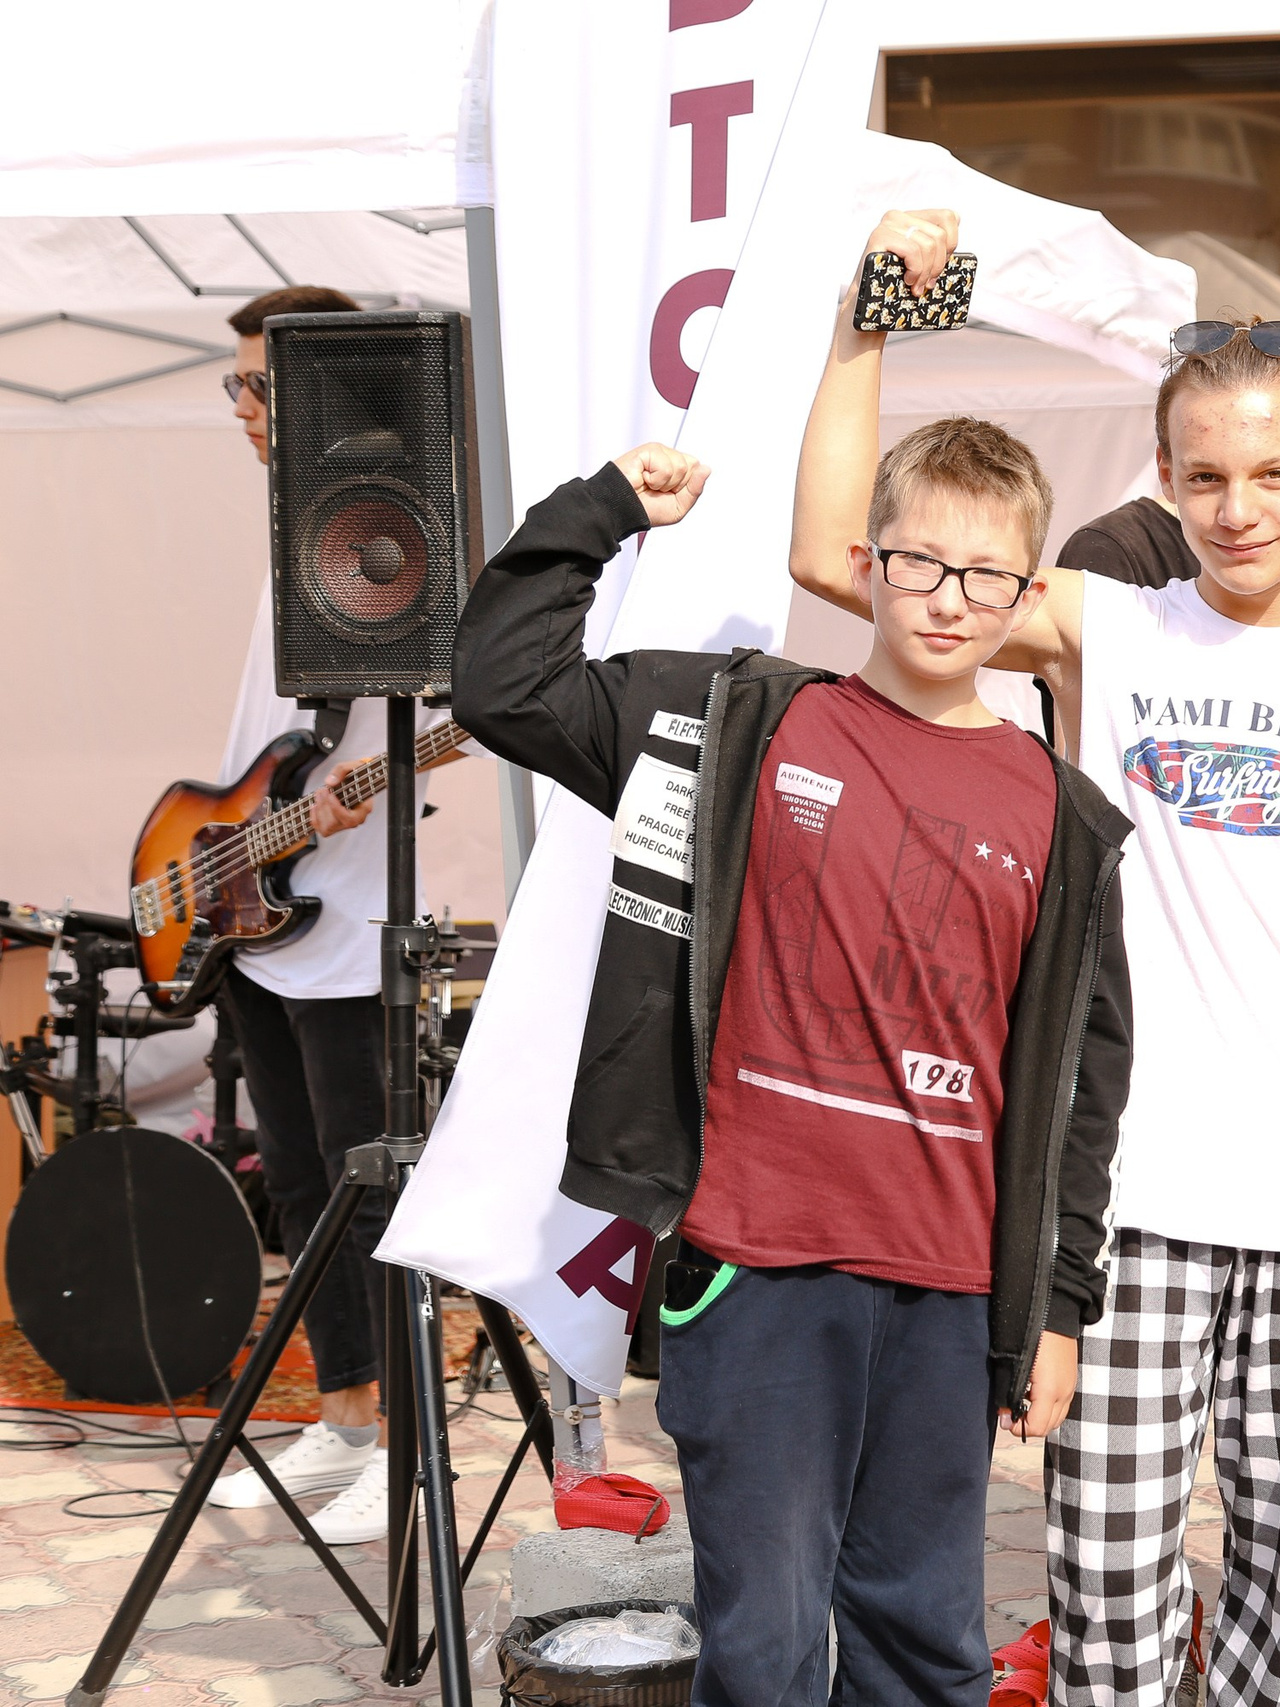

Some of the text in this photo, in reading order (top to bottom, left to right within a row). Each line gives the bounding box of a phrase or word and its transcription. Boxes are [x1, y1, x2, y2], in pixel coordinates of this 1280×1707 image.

[665, 780, 695, 800] DARK
[780, 771, 836, 794] AUTHENIC
[663, 802, 692, 820] FREE
[781, 794, 829, 813] INNOVATION
[788, 805, 826, 822] APPAREL
[793, 815, 825, 830] DESIGN
[637, 814, 686, 841] PRAGUE
[624, 830, 690, 864] HUREICANE
